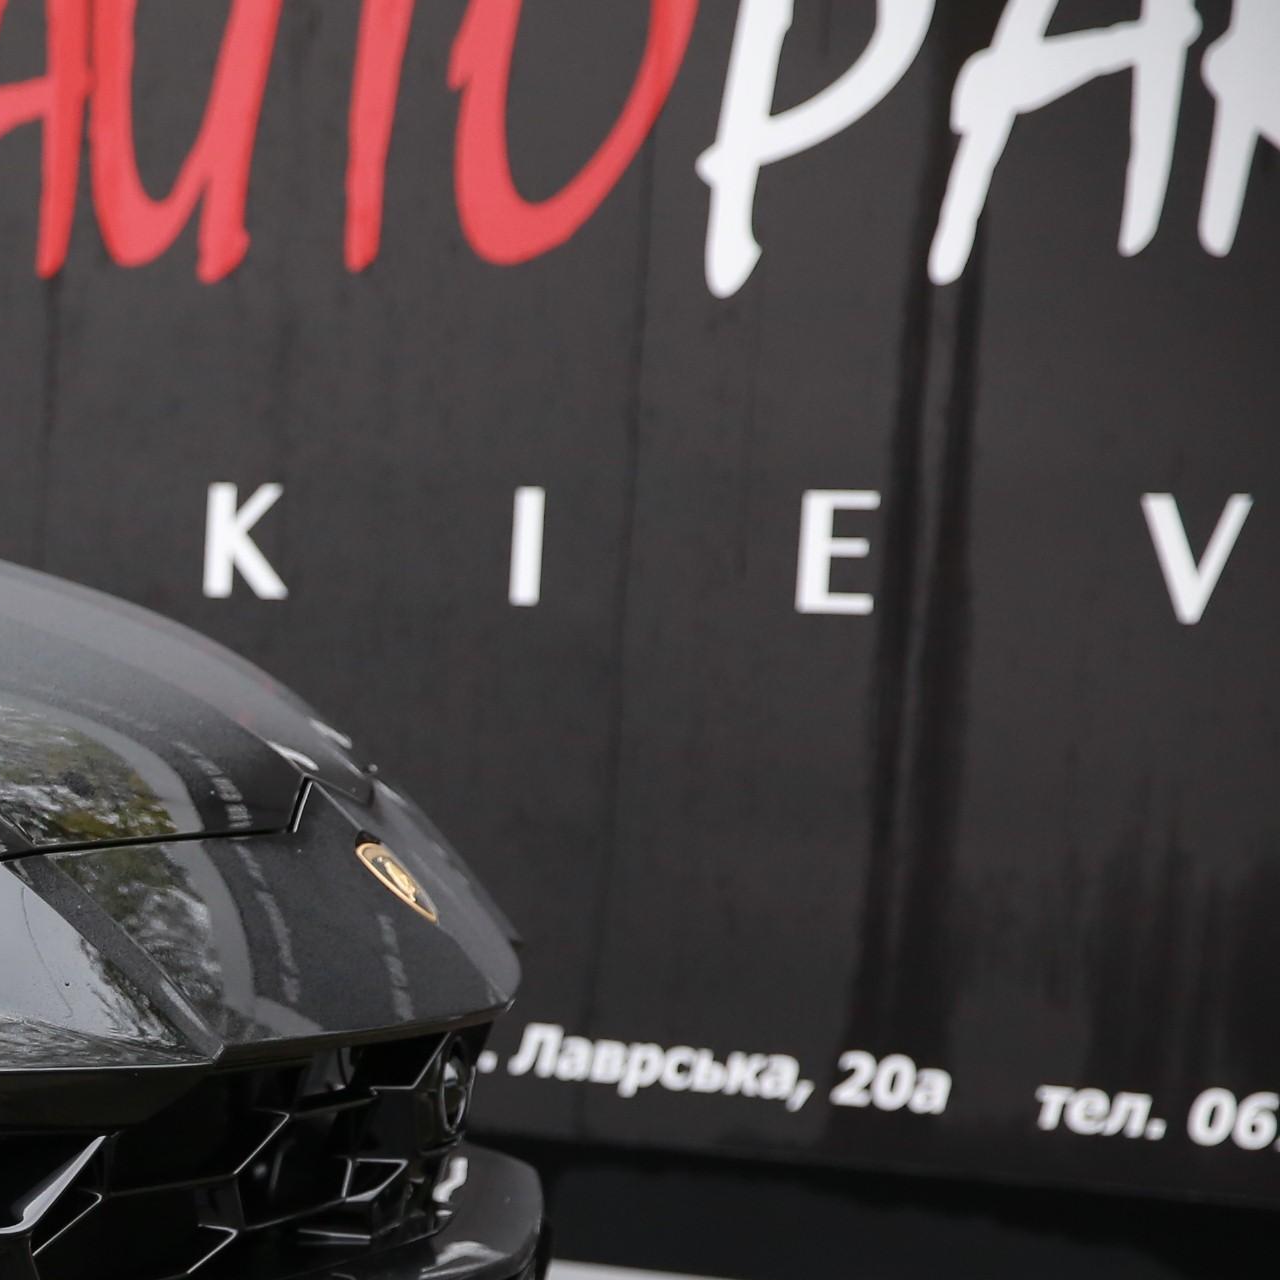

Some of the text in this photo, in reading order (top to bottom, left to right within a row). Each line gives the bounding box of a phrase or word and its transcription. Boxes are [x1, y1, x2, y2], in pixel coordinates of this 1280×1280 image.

[507, 1022, 1280, 1151] Лаврська, 20а тел. 06
